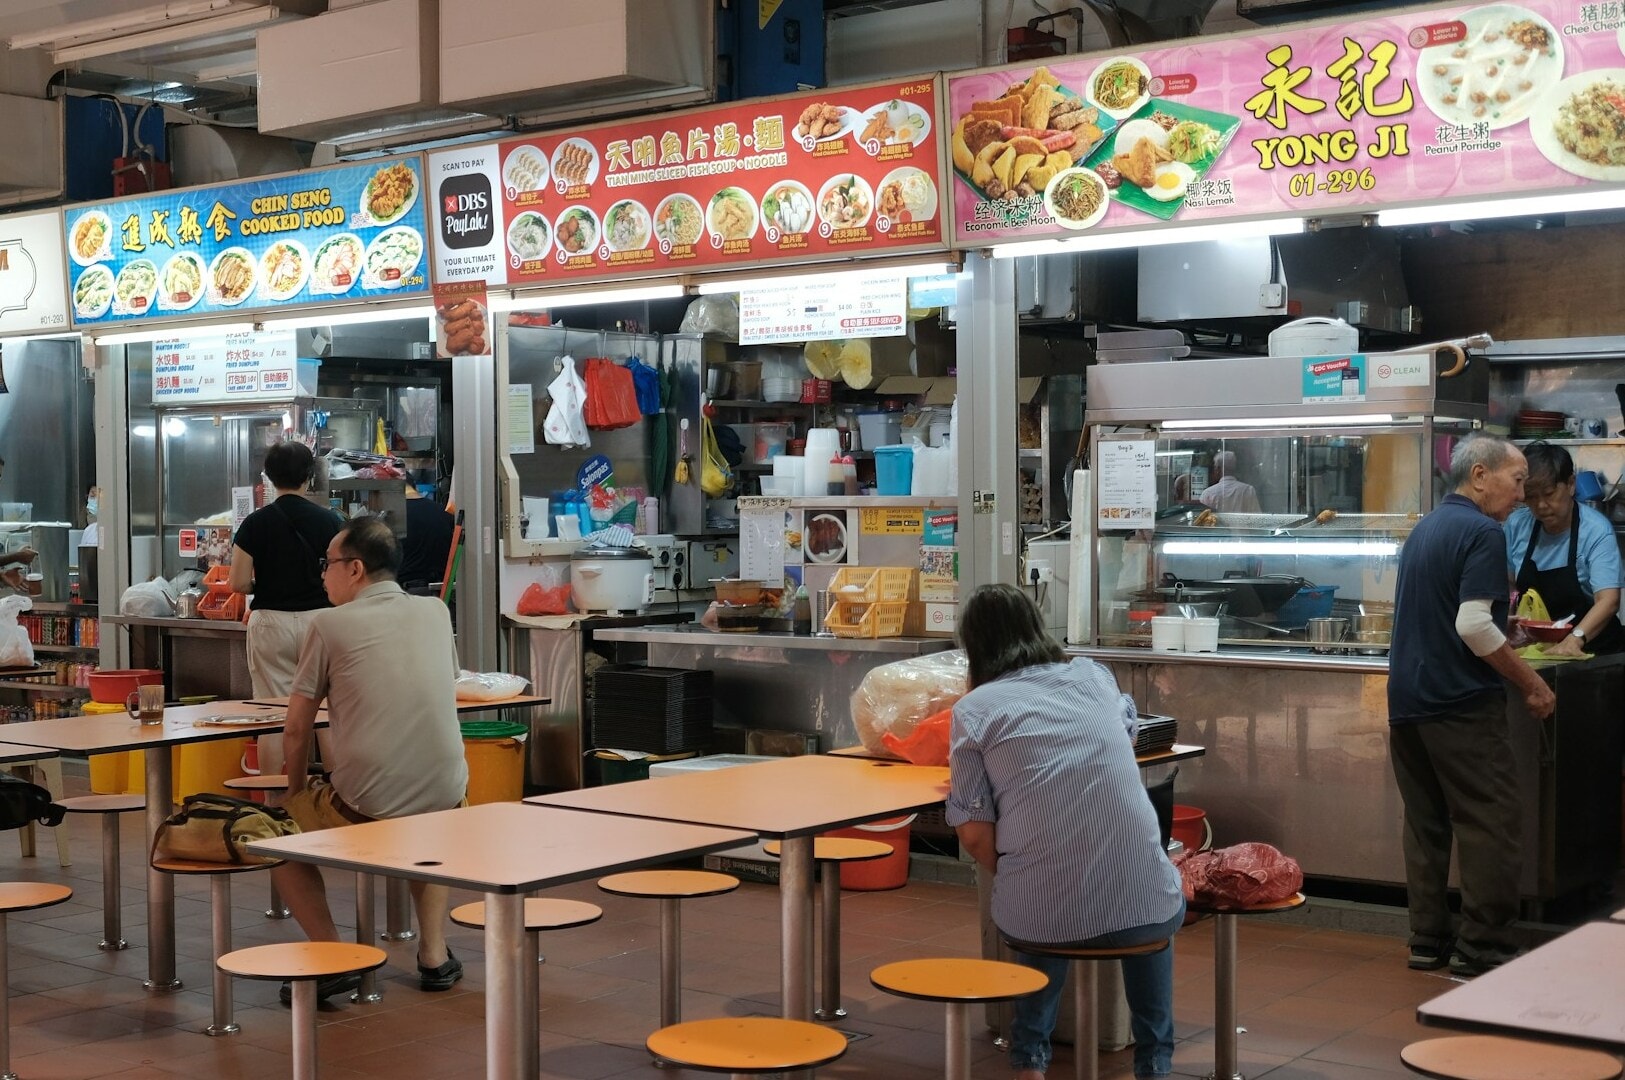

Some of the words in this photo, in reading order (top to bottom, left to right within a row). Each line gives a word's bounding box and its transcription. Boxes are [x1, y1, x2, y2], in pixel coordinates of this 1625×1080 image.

[1433, 27, 1451, 35] Lower
[1433, 32, 1458, 41] calories
[1564, 25, 1590, 35] Chee
[900, 84, 931, 95] #01-295
[1244, 37, 1414, 129] 永記
[1437, 122, 1489, 143] 花生粥
[804, 139, 814, 148] 12
[868, 143, 877, 152] 11
[1252, 129, 1359, 169] YONG
[1368, 123, 1410, 158] JI
[1425, 144, 1458, 155] Peanut
[1461, 141, 1501, 152] Porridge
[442, 162, 460, 171] SCAN
[472, 159, 485, 167] PAY
[605, 175, 629, 187] TIAN
[629, 171, 655, 184] MING
[656, 167, 687, 181] SLICED
[688, 164, 710, 177] FISH
[710, 161, 736, 174] SOUP
[745, 153, 787, 170] NOODLE
[1289, 167, 1376, 197] 01-296
[1186, 180, 1232, 198] 椰浆饭
[251, 194, 288, 214] CHIN
[291, 188, 331, 210] SENG
[458, 192, 487, 211] DBS
[975, 195, 1044, 220] 经济米粉
[1184, 198, 1204, 208] Nasi
[1206, 196, 1235, 206] Lemak
[240, 214, 300, 236] COOKED
[302, 207, 345, 228] FOOD
[446, 212, 488, 236] PayLah!
[878, 220, 888, 229] 10
[965, 221, 1009, 232] Economic
[1011, 218, 1027, 228] Bee
[1030, 216, 1056, 226] Hoon
[444, 258, 462, 267] YOUR
[463, 254, 496, 264] ULTIMATE
[447, 266, 479, 276] EVERYDAY
[40, 315, 64, 325] #01-293
[870, 316, 899, 325] SELF-SERVICE
[1326, 361, 1348, 371] Voucher
[1393, 367, 1421, 375] CLEAN
[581, 462, 609, 489] Salonpas
[733, 861, 767, 875] Heineken
